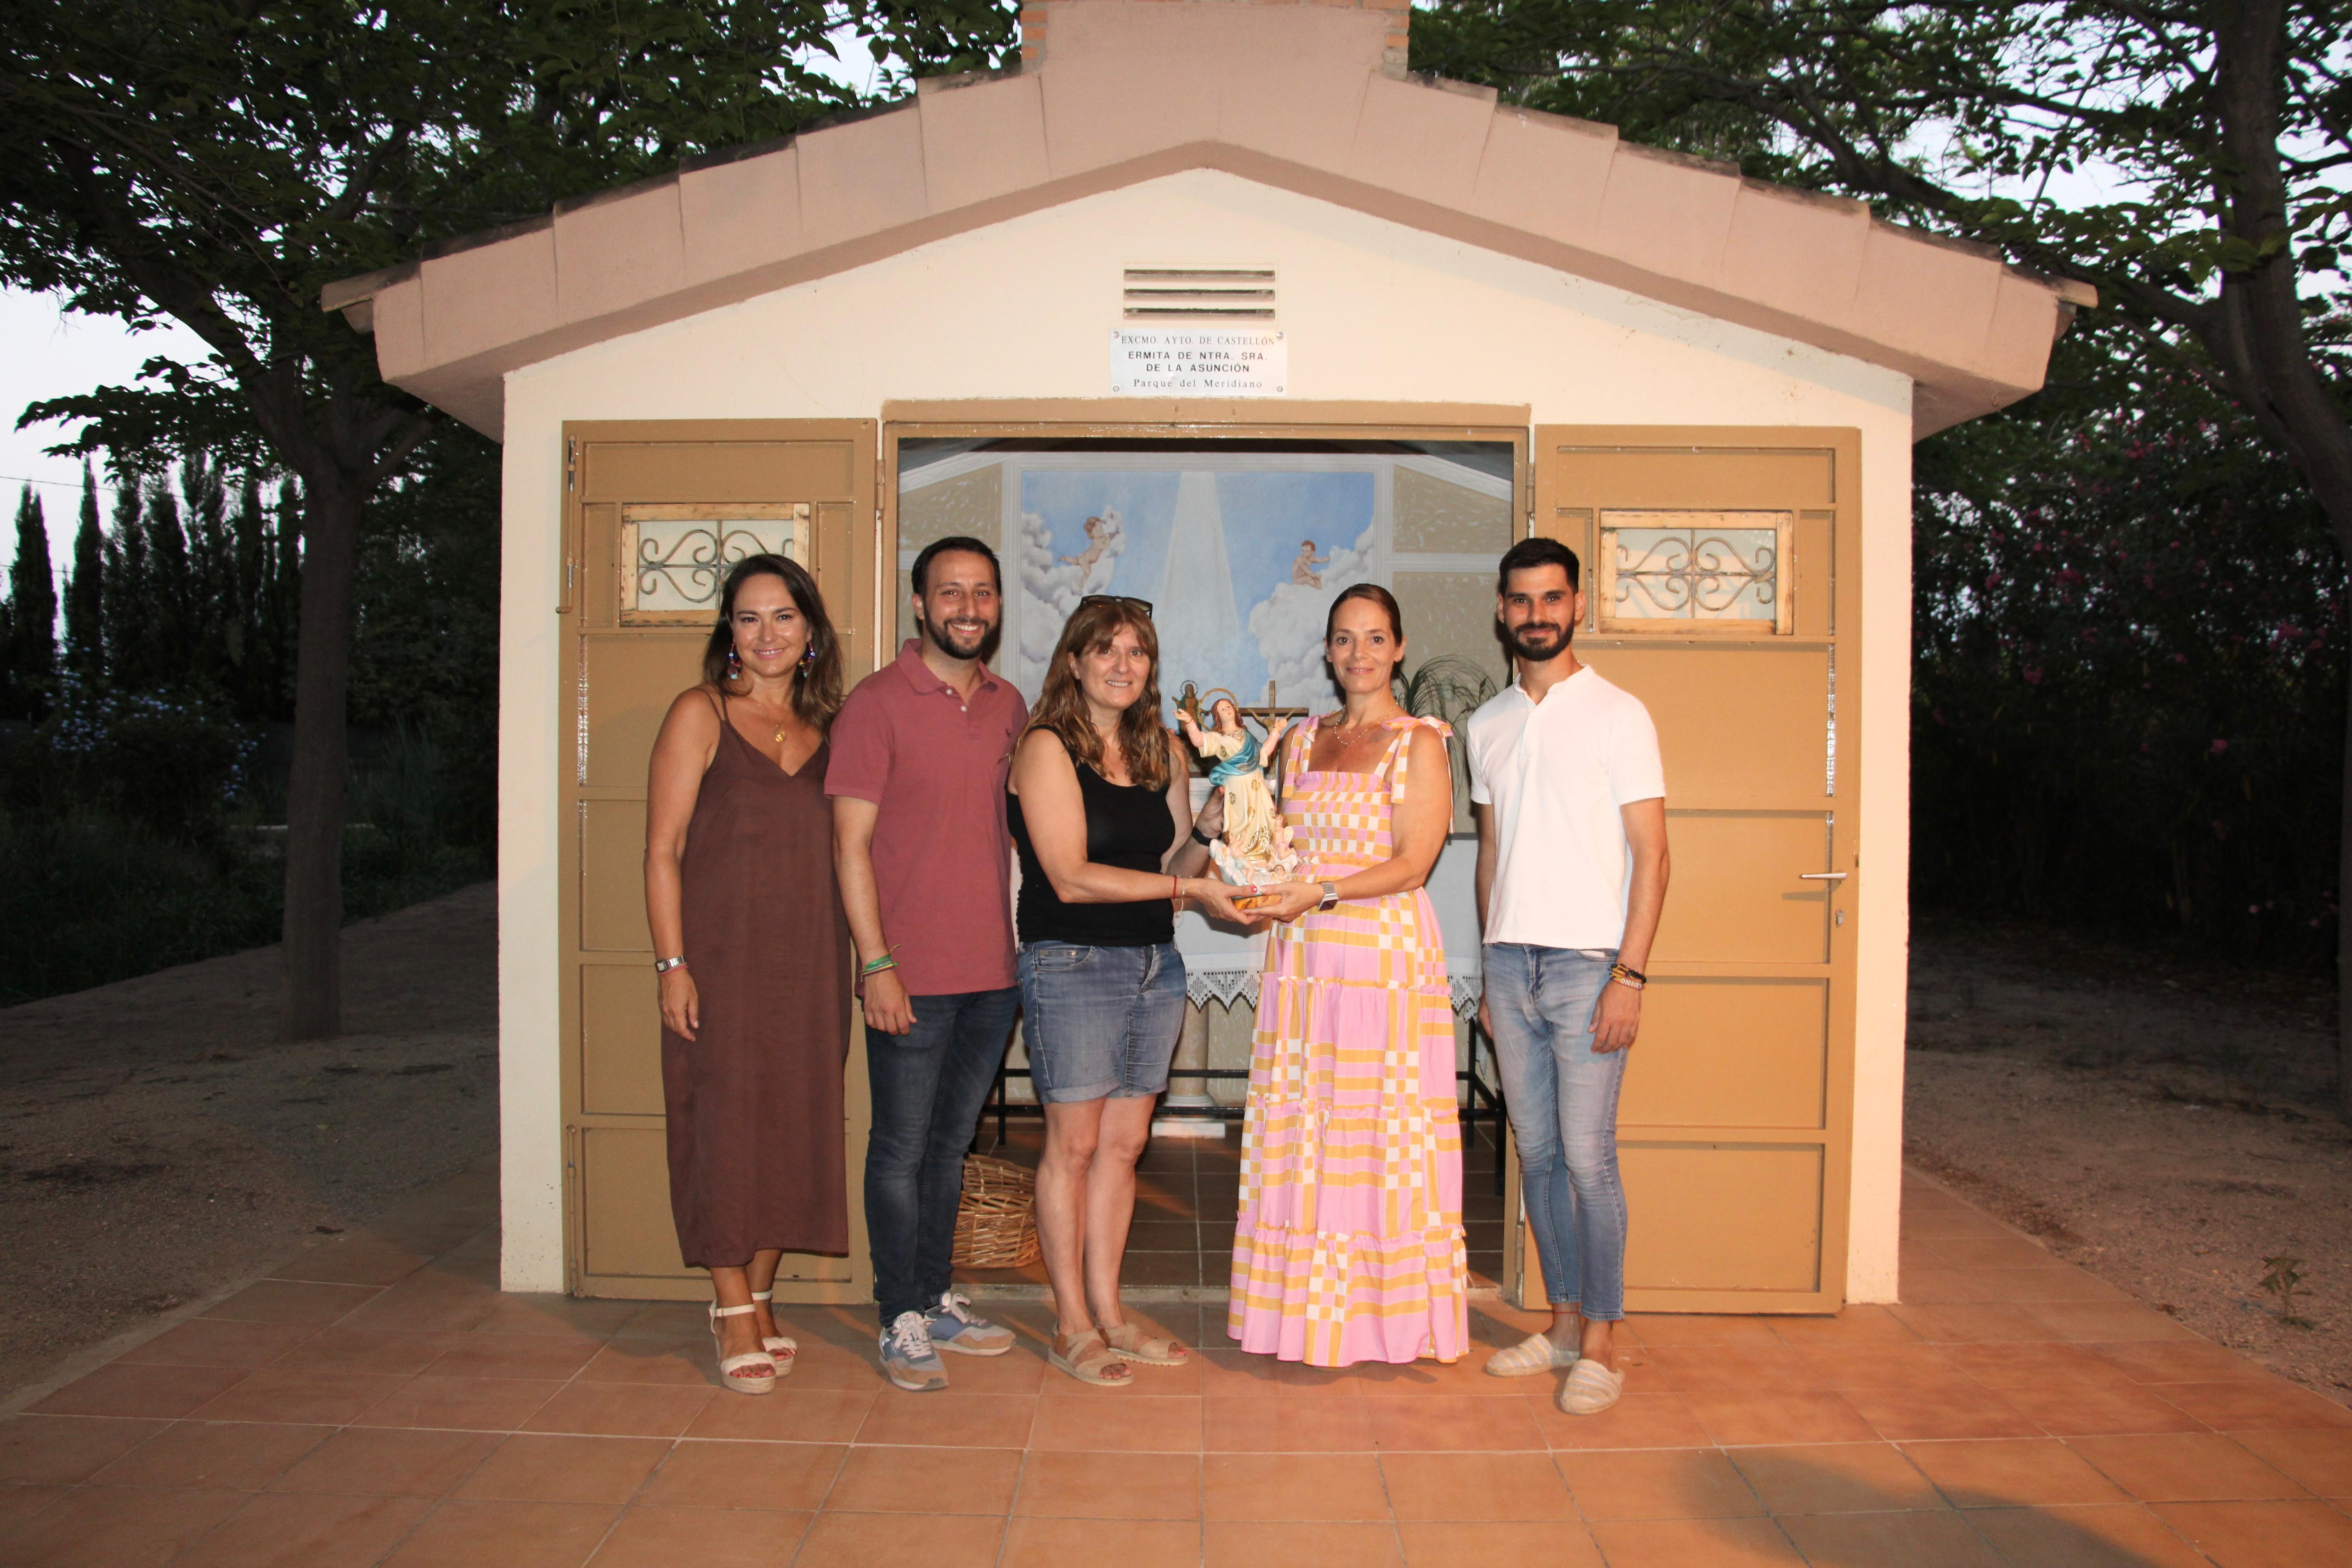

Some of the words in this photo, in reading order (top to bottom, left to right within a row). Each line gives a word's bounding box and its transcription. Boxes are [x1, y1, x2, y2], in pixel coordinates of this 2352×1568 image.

[1121, 336, 1159, 344] EXCMO.
[1199, 336, 1212, 344] DE
[1217, 336, 1275, 345] CASTELLÓN
[1128, 351, 1170, 359] ERMITA
[1178, 351, 1192, 360] DE
[1241, 352, 1267, 361] SRA.
[1190, 363, 1249, 372] ASUNCIÓN
[1134, 379, 1172, 388] Parque
[1180, 379, 1195, 387] del
[1204, 379, 1262, 388] Meridiano
